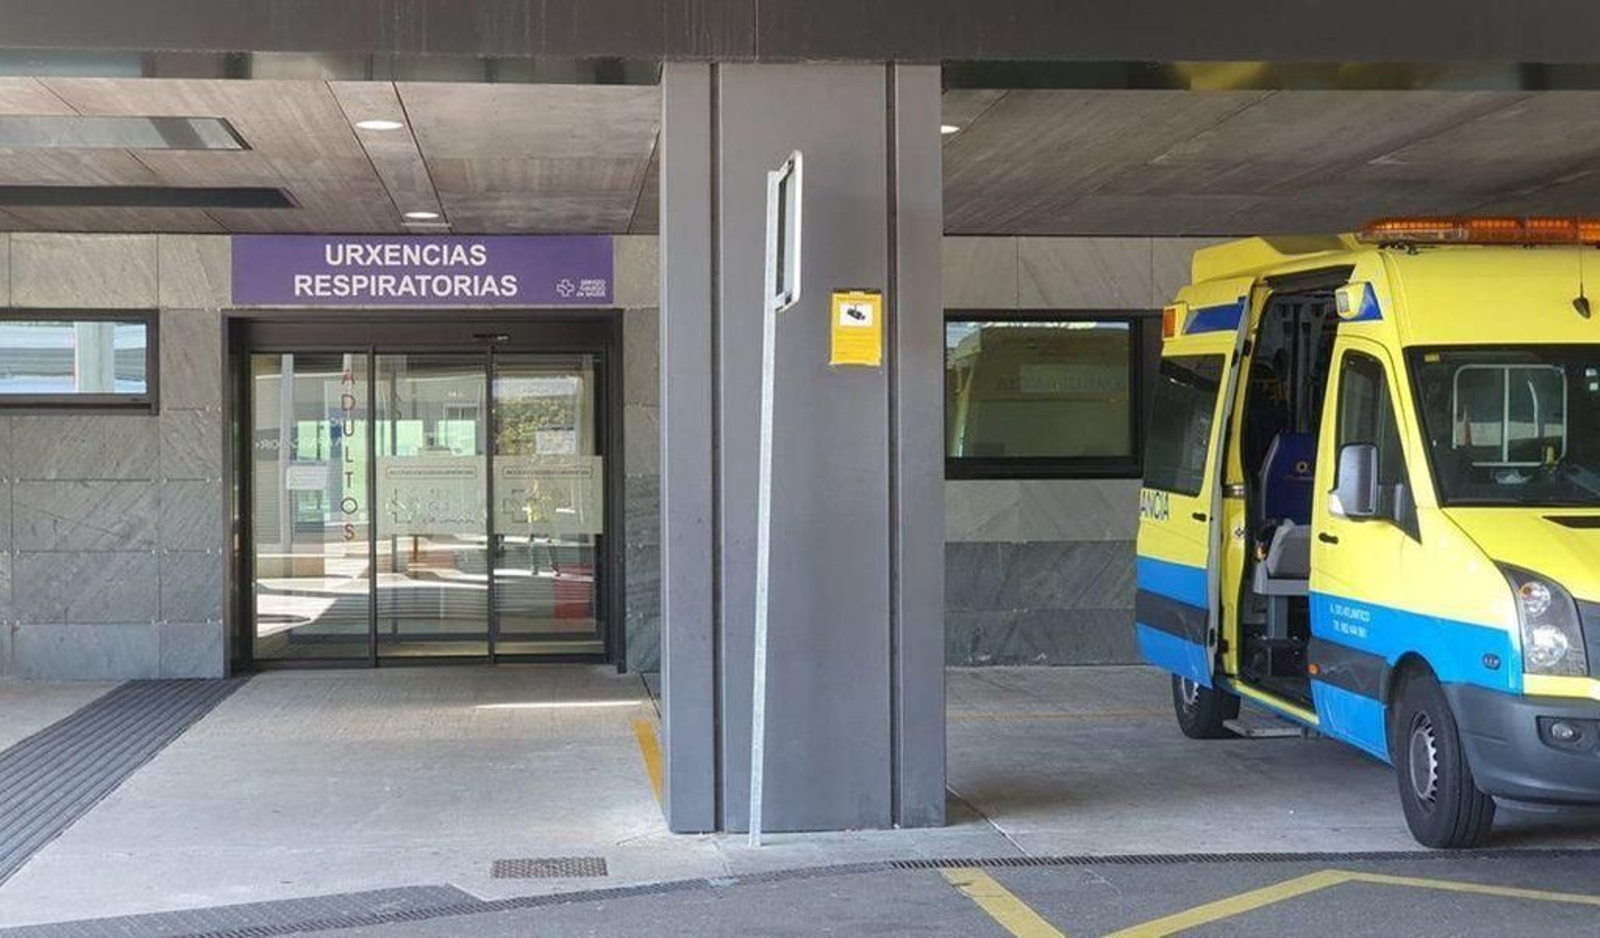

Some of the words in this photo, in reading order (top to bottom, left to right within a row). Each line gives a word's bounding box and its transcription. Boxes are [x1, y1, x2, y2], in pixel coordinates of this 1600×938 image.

[325, 244, 487, 266] URXENCIAS
[294, 274, 518, 297] RESPIRATORIAS
[341, 370, 358, 540] ADULTOS
